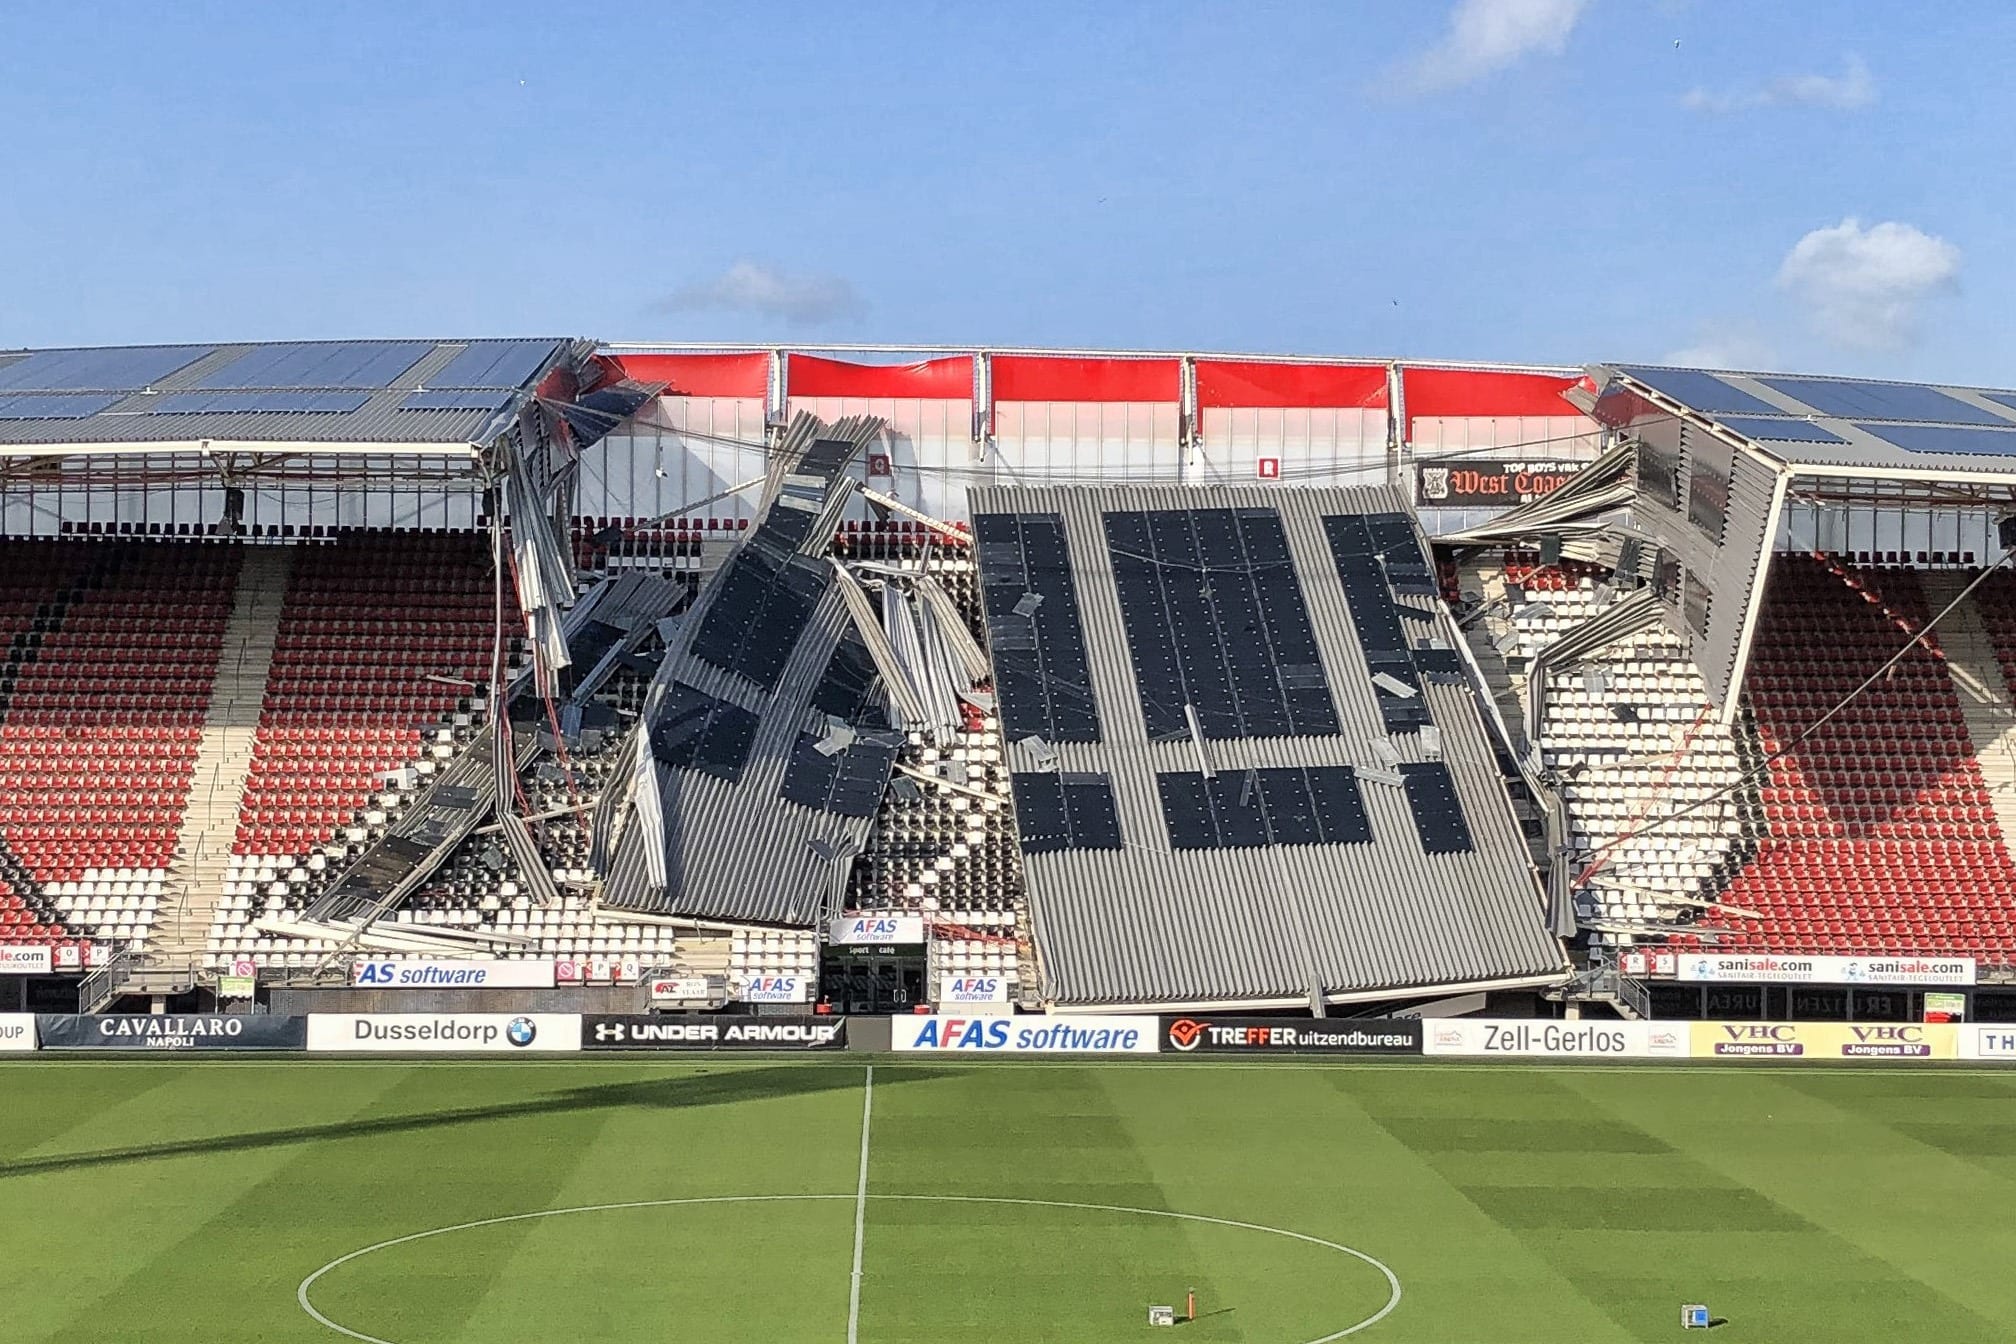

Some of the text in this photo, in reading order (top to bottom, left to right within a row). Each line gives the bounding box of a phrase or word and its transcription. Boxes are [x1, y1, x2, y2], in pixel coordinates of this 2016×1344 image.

[1263, 460, 1274, 475] R
[1503, 464, 1526, 474] TOP
[1527, 463, 1555, 473] BOYS
[1450, 470, 1509, 494] West
[853, 919, 897, 933] AFAS
[856, 932, 894, 941] software
[849, 945, 869, 955] Sport
[1718, 958, 1813, 972] sanisale.com
[1868, 960, 1964, 974] sanisale.com
[400, 966, 486, 984] software
[750, 978, 795, 992] AFAS
[951, 978, 997, 993] AFAS
[753, 990, 792, 1000] software
[954, 991, 993, 1001] software
[100, 1018, 242, 1036] CAVALLARO
[355, 1019, 498, 1044] Dusseldorp
[631, 1025, 834, 1041] UNDER ARMOUR
[913, 1019, 1138, 1049] AFAS software
[1722, 1025, 1796, 1042] VHC
[146, 1036, 194, 1046] NAPOLI
[1208, 1027, 1413, 1047] TREFFER uitzendbureau
[1484, 1025, 1625, 1052] Zell-Gerlos
[1850, 1026, 1923, 1043] VHC
[1720, 1044, 1795, 1055] Jongens BV
[1848, 1045, 1922, 1056] Jongens BV
